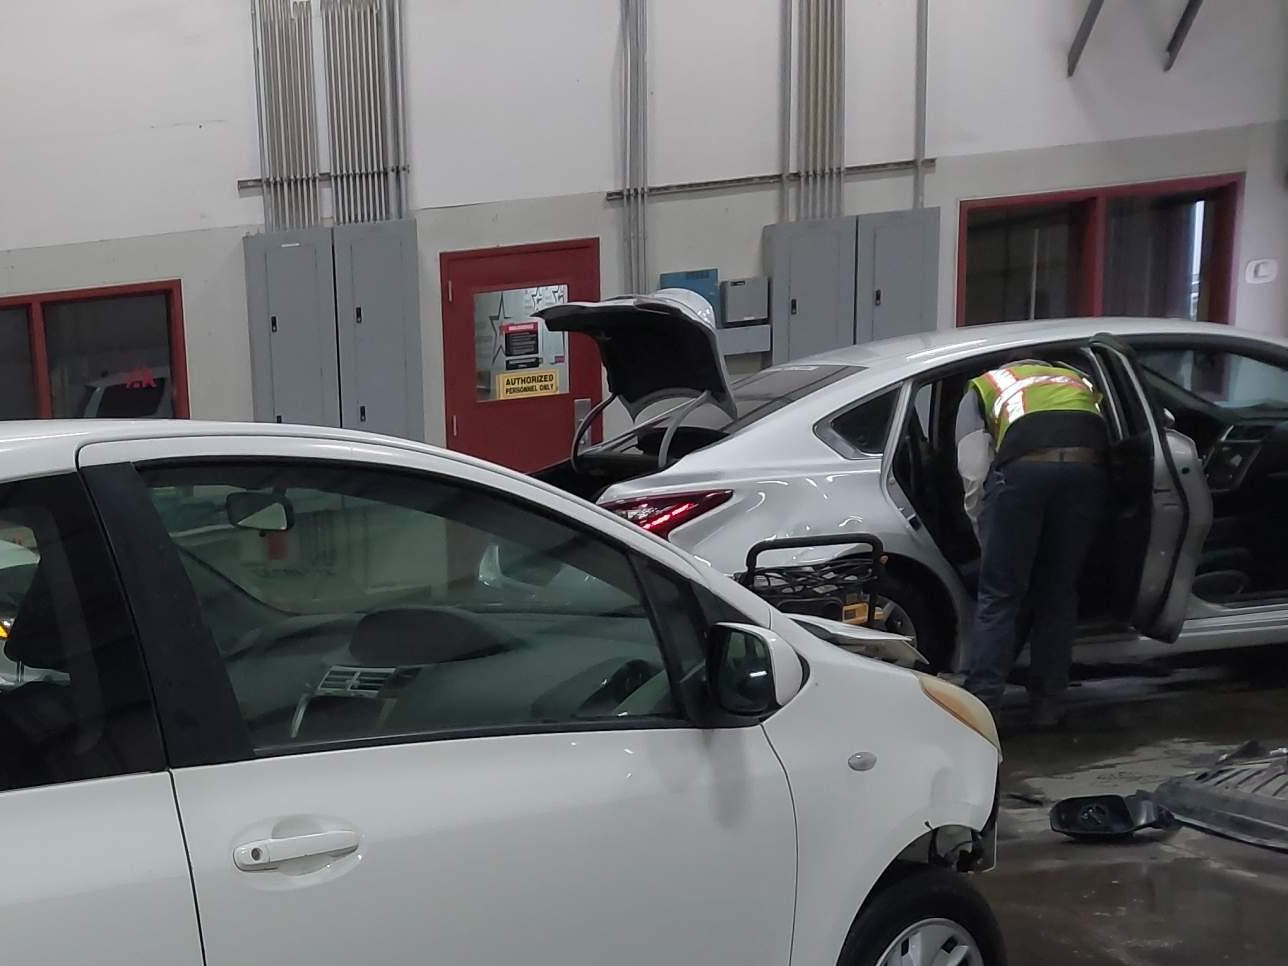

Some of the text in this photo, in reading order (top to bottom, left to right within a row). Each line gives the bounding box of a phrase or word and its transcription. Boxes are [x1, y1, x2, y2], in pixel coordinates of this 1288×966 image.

[505, 374, 554, 386] AUTHORIZED
[505, 384, 554, 395] PERSONNEL ONLY
